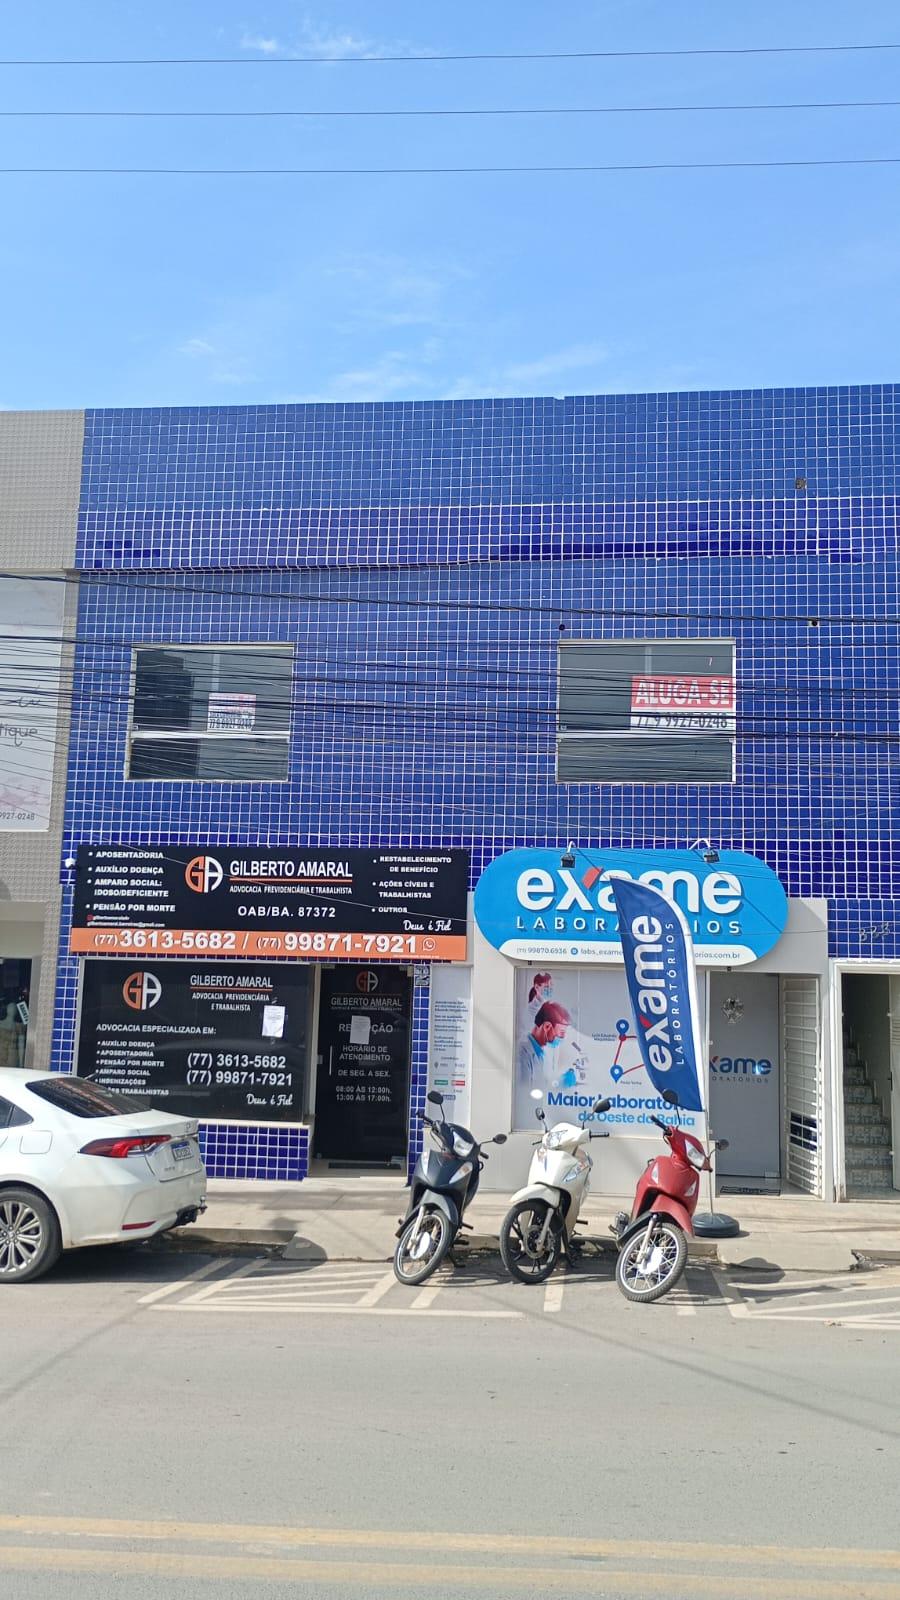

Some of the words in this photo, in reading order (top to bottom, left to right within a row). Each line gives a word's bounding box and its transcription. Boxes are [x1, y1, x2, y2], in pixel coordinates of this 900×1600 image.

[636, 680, 729, 705] ALUGA-SE
[96, 851, 164, 859] APOSENTADORIA
[380, 856, 452, 864] RESTABELECIMENTO
[230, 860, 295, 876] GILBERTO
[298, 862, 353, 877] AMARAL
[130, 879, 162, 887] SOCIAL:
[379, 880, 402, 889] AÇÕES
[404, 880, 427, 888] CÍVEIS
[95, 889, 169, 897] IDOSO/DEFICIENTE
[230, 885, 262, 893] ADVOCACIA
[264, 885, 310, 894] PREVIDENCIÁRIA
[311, 886, 315, 894] E
[316, 886, 353, 895] TRABALHISTA
[379, 891, 432, 899] TRABALHISTAS
[93, 903, 126, 911] PENSÃO
[238, 906, 294, 917] OAB/BA.
[298, 907, 336, 917] 87372
[403, 920, 424, 931] Deus
[428, 921, 434, 931] é
[434, 920, 452, 931] Fiel
[516, 915, 741, 933] LABORIOS
[95, 934, 118, 946] (77)
[120, 930, 236, 950] 3613-5682
[257, 938, 281, 950] (77)
[284, 933, 416, 953] 99871-7921
[190, 974, 234, 987] GILBERTO
[236, 976, 274, 988] AMARAL
[192, 992, 224, 1001] ADVOCACIA
[225, 992, 270, 1001] PREVIDENCIÁRIA
[631, 915, 673, 1072] exame
[666, 923, 684, 1065] LABORATÓRIOS
[331, 997, 368, 1006] GILBERTO
[370, 998, 402, 1007] AMARAL
[216, 1003, 251, 1012] TRABALHISTA
[96, 1023, 140, 1032] ADVOCACIA
[142, 1025, 201, 1034] ESPECIALIZADA
[203, 1026, 216, 1035] EM:
[339, 1023, 393, 1034] REÇÃO
[101, 1039, 127, 1047] AUXÍLIO
[129, 1041, 155, 1049] DOENÇA
[343, 1045, 376, 1053] HORÁRIO
[187, 1052, 213, 1069] (77)
[216, 1053, 286, 1069] 3613-5682
[340, 1053, 391, 1061] ATENDIMENTO
[100, 1059, 125, 1067] PENSÃO
[99, 1078, 146, 1086] INDENIZAÇÕES
[186, 1070, 212, 1086] (77)
[216, 1071, 292, 1086] 99871-7921
[121, 1088, 169, 1096] TRABALHISTAS
[247, 1093, 266, 1105] Deus
[270, 1095, 275, 1105] é
[277, 1093, 293, 1106] Fiel
[548, 1092, 594, 1106] Maior
[578, 1111, 594, 1121] do
[597, 1111, 634, 1123] Oeste
[658, 1114, 695, 1126] Bahia
